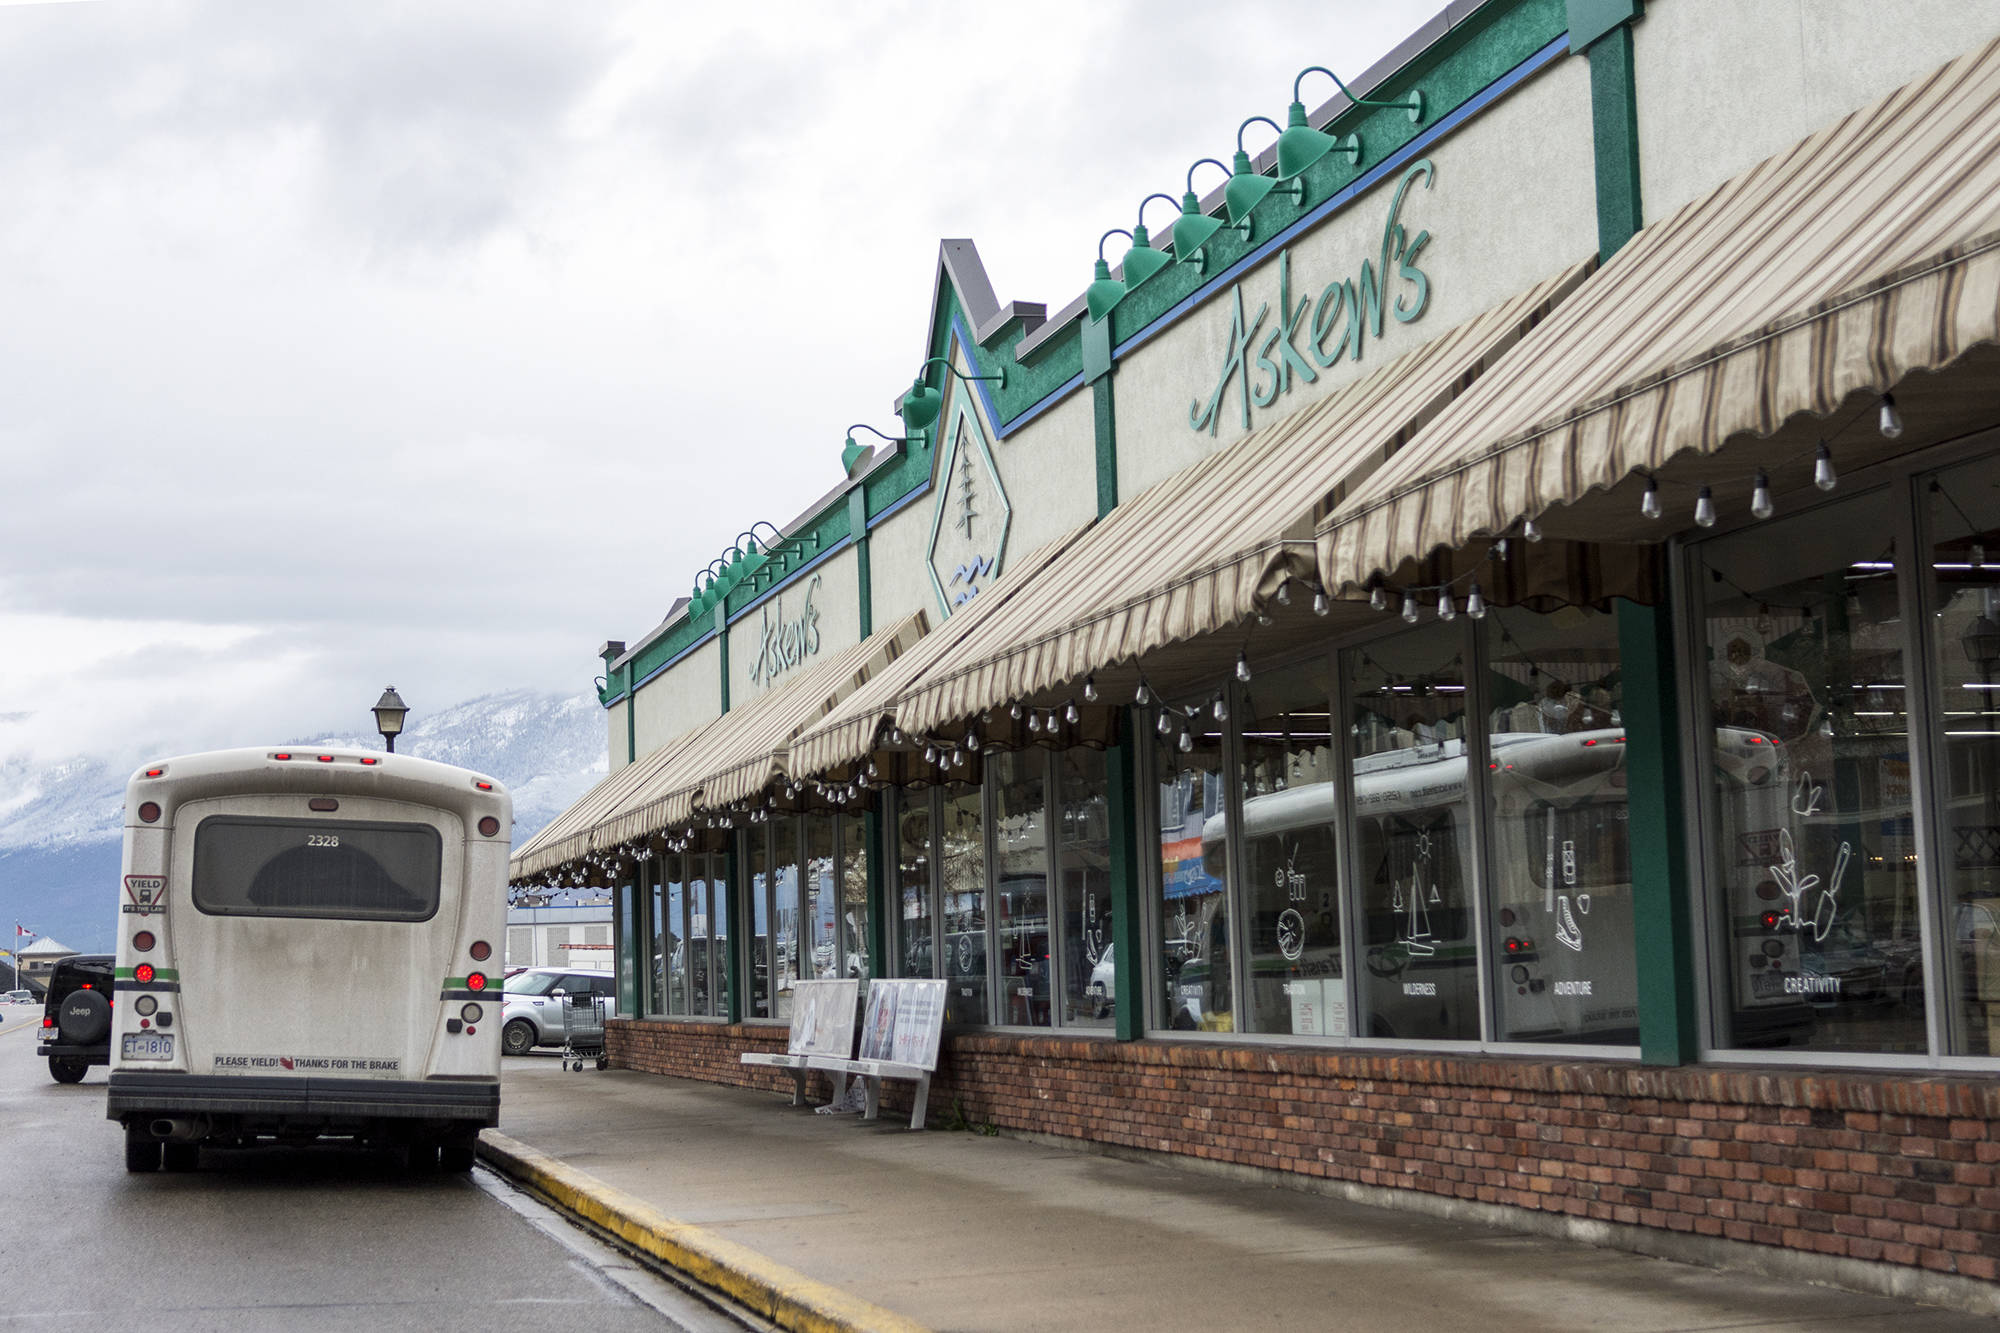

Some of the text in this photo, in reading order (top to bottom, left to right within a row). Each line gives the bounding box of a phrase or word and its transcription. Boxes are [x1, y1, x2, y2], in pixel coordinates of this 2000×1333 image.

[1189, 158, 1433, 438] Askew's
[748, 572, 821, 688] Askew's
[307, 835, 339, 847] 2328
[130, 880, 161, 888] YIELD
[1403, 983, 1436, 996] WILDERNESS
[1554, 981, 1593, 996] ADVENTURE
[1784, 977, 1841, 993] CREATIVITY
[69, 1007, 91, 1017] Jeep
[215, 1056, 398, 1070] PLEASE YIELD! THANKS FOR THE BRAKE
